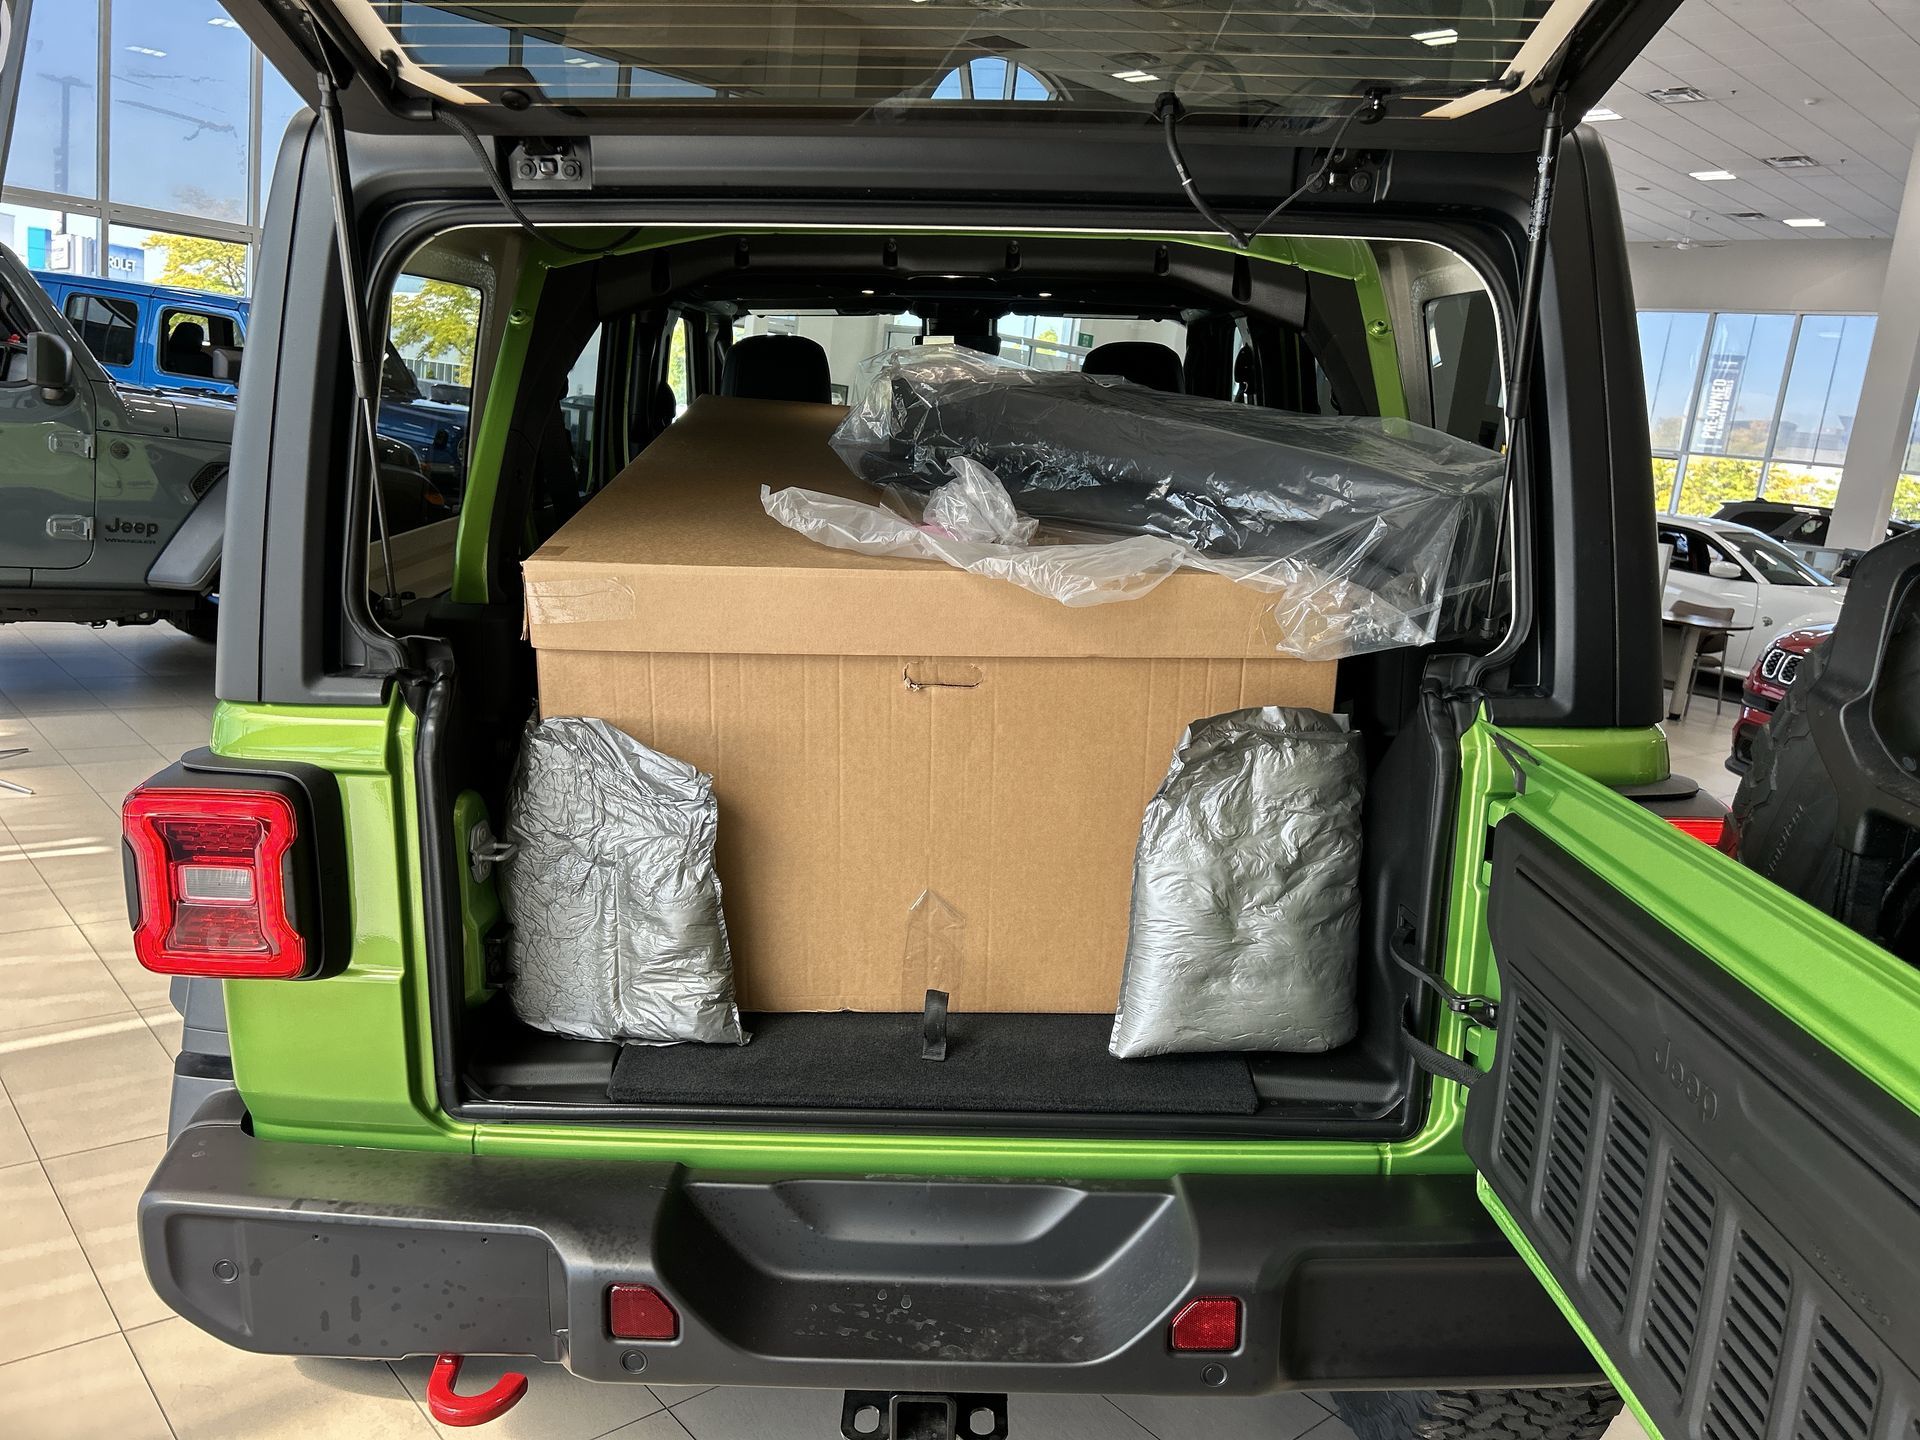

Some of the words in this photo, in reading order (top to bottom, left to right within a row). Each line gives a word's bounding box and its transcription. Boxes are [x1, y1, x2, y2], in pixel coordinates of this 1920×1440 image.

[1537, 156, 1554, 164] ODY
[1701, 378, 1727, 439] PRE-OWNED
[105, 517, 159, 538] Jeep
[1653, 1038, 1718, 1124] Jeep
